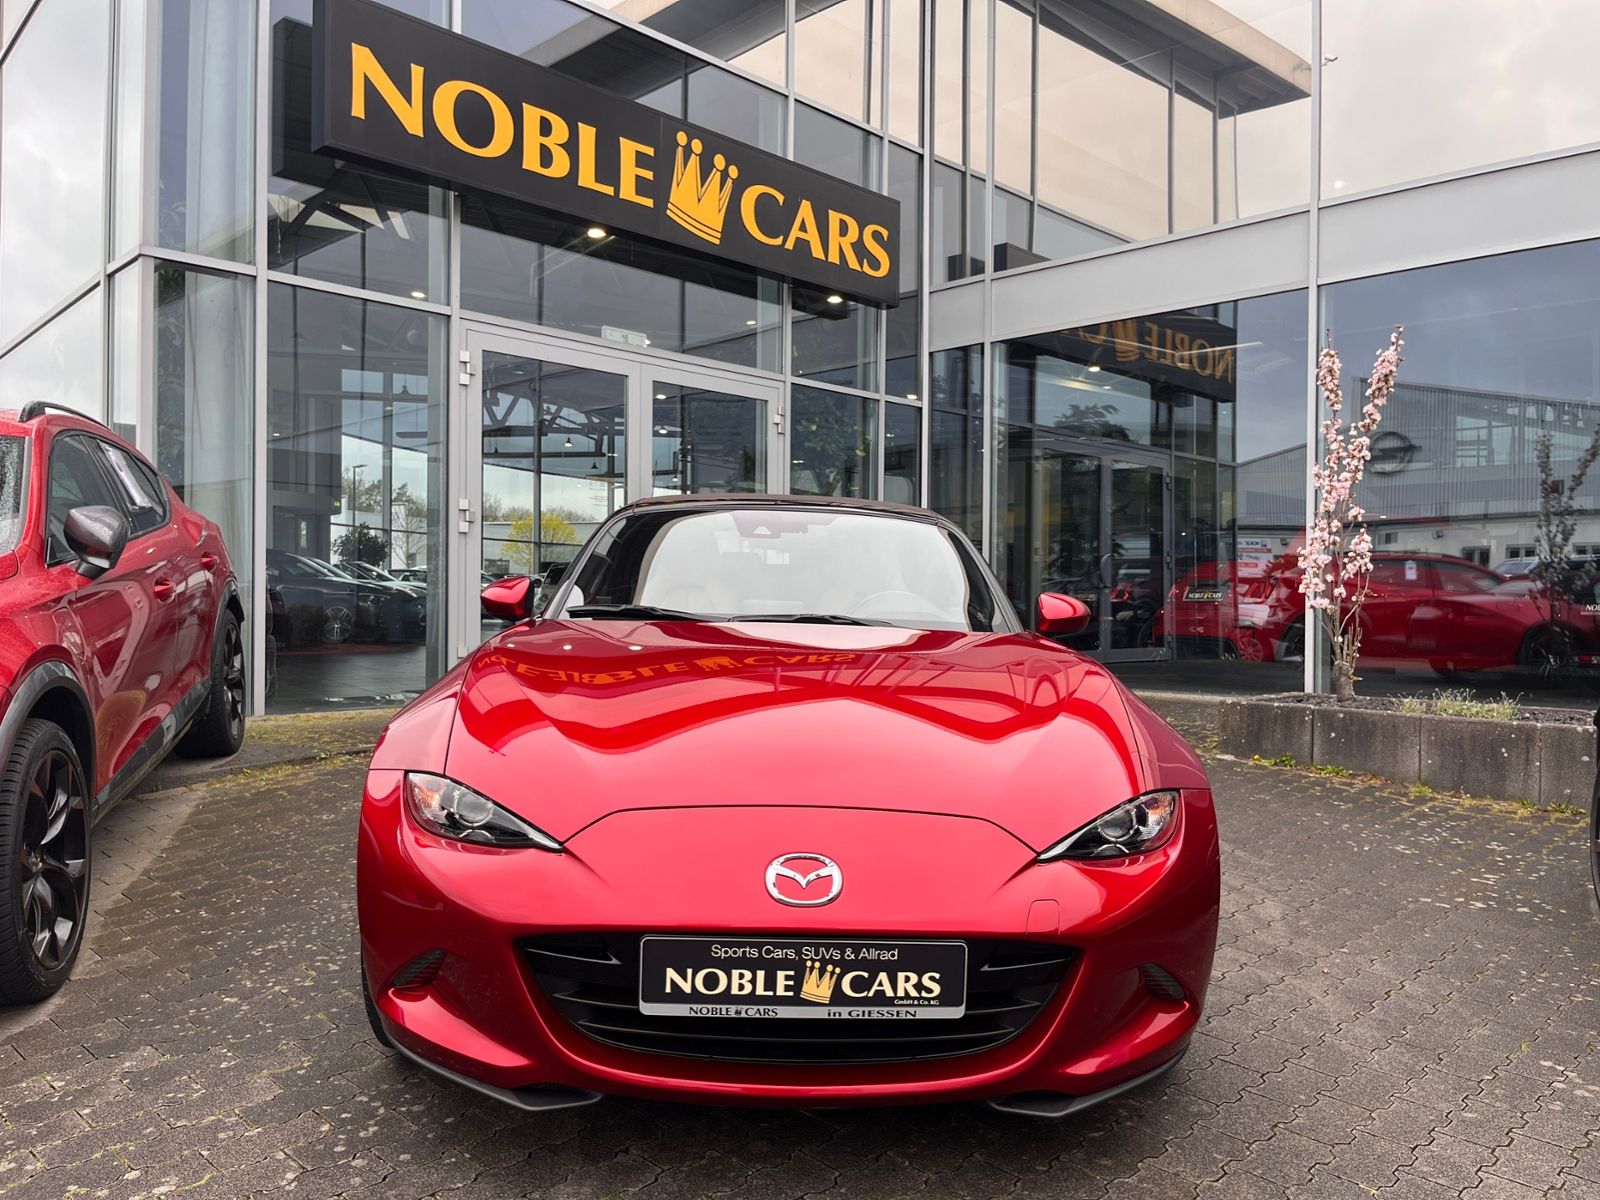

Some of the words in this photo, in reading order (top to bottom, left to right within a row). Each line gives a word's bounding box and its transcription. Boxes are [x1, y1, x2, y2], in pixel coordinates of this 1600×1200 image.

[351, 43, 655, 208] NOBLE
[740, 184, 890, 278] CARS
[711, 944, 759, 960] Sports
[762, 945, 799, 961] Cars,
[801, 946, 841, 960] SUVs
[844, 947, 856, 960] &
[858, 948, 898, 961] Allrad
[664, 967, 795, 997] NOBLE
[841, 970, 941, 998] CARS
[688, 1006, 732, 1016] NOBLE
[744, 1007, 778, 1017] CARS
[827, 1009, 842, 1018] in
[847, 1009, 917, 1018] GIESSEN
